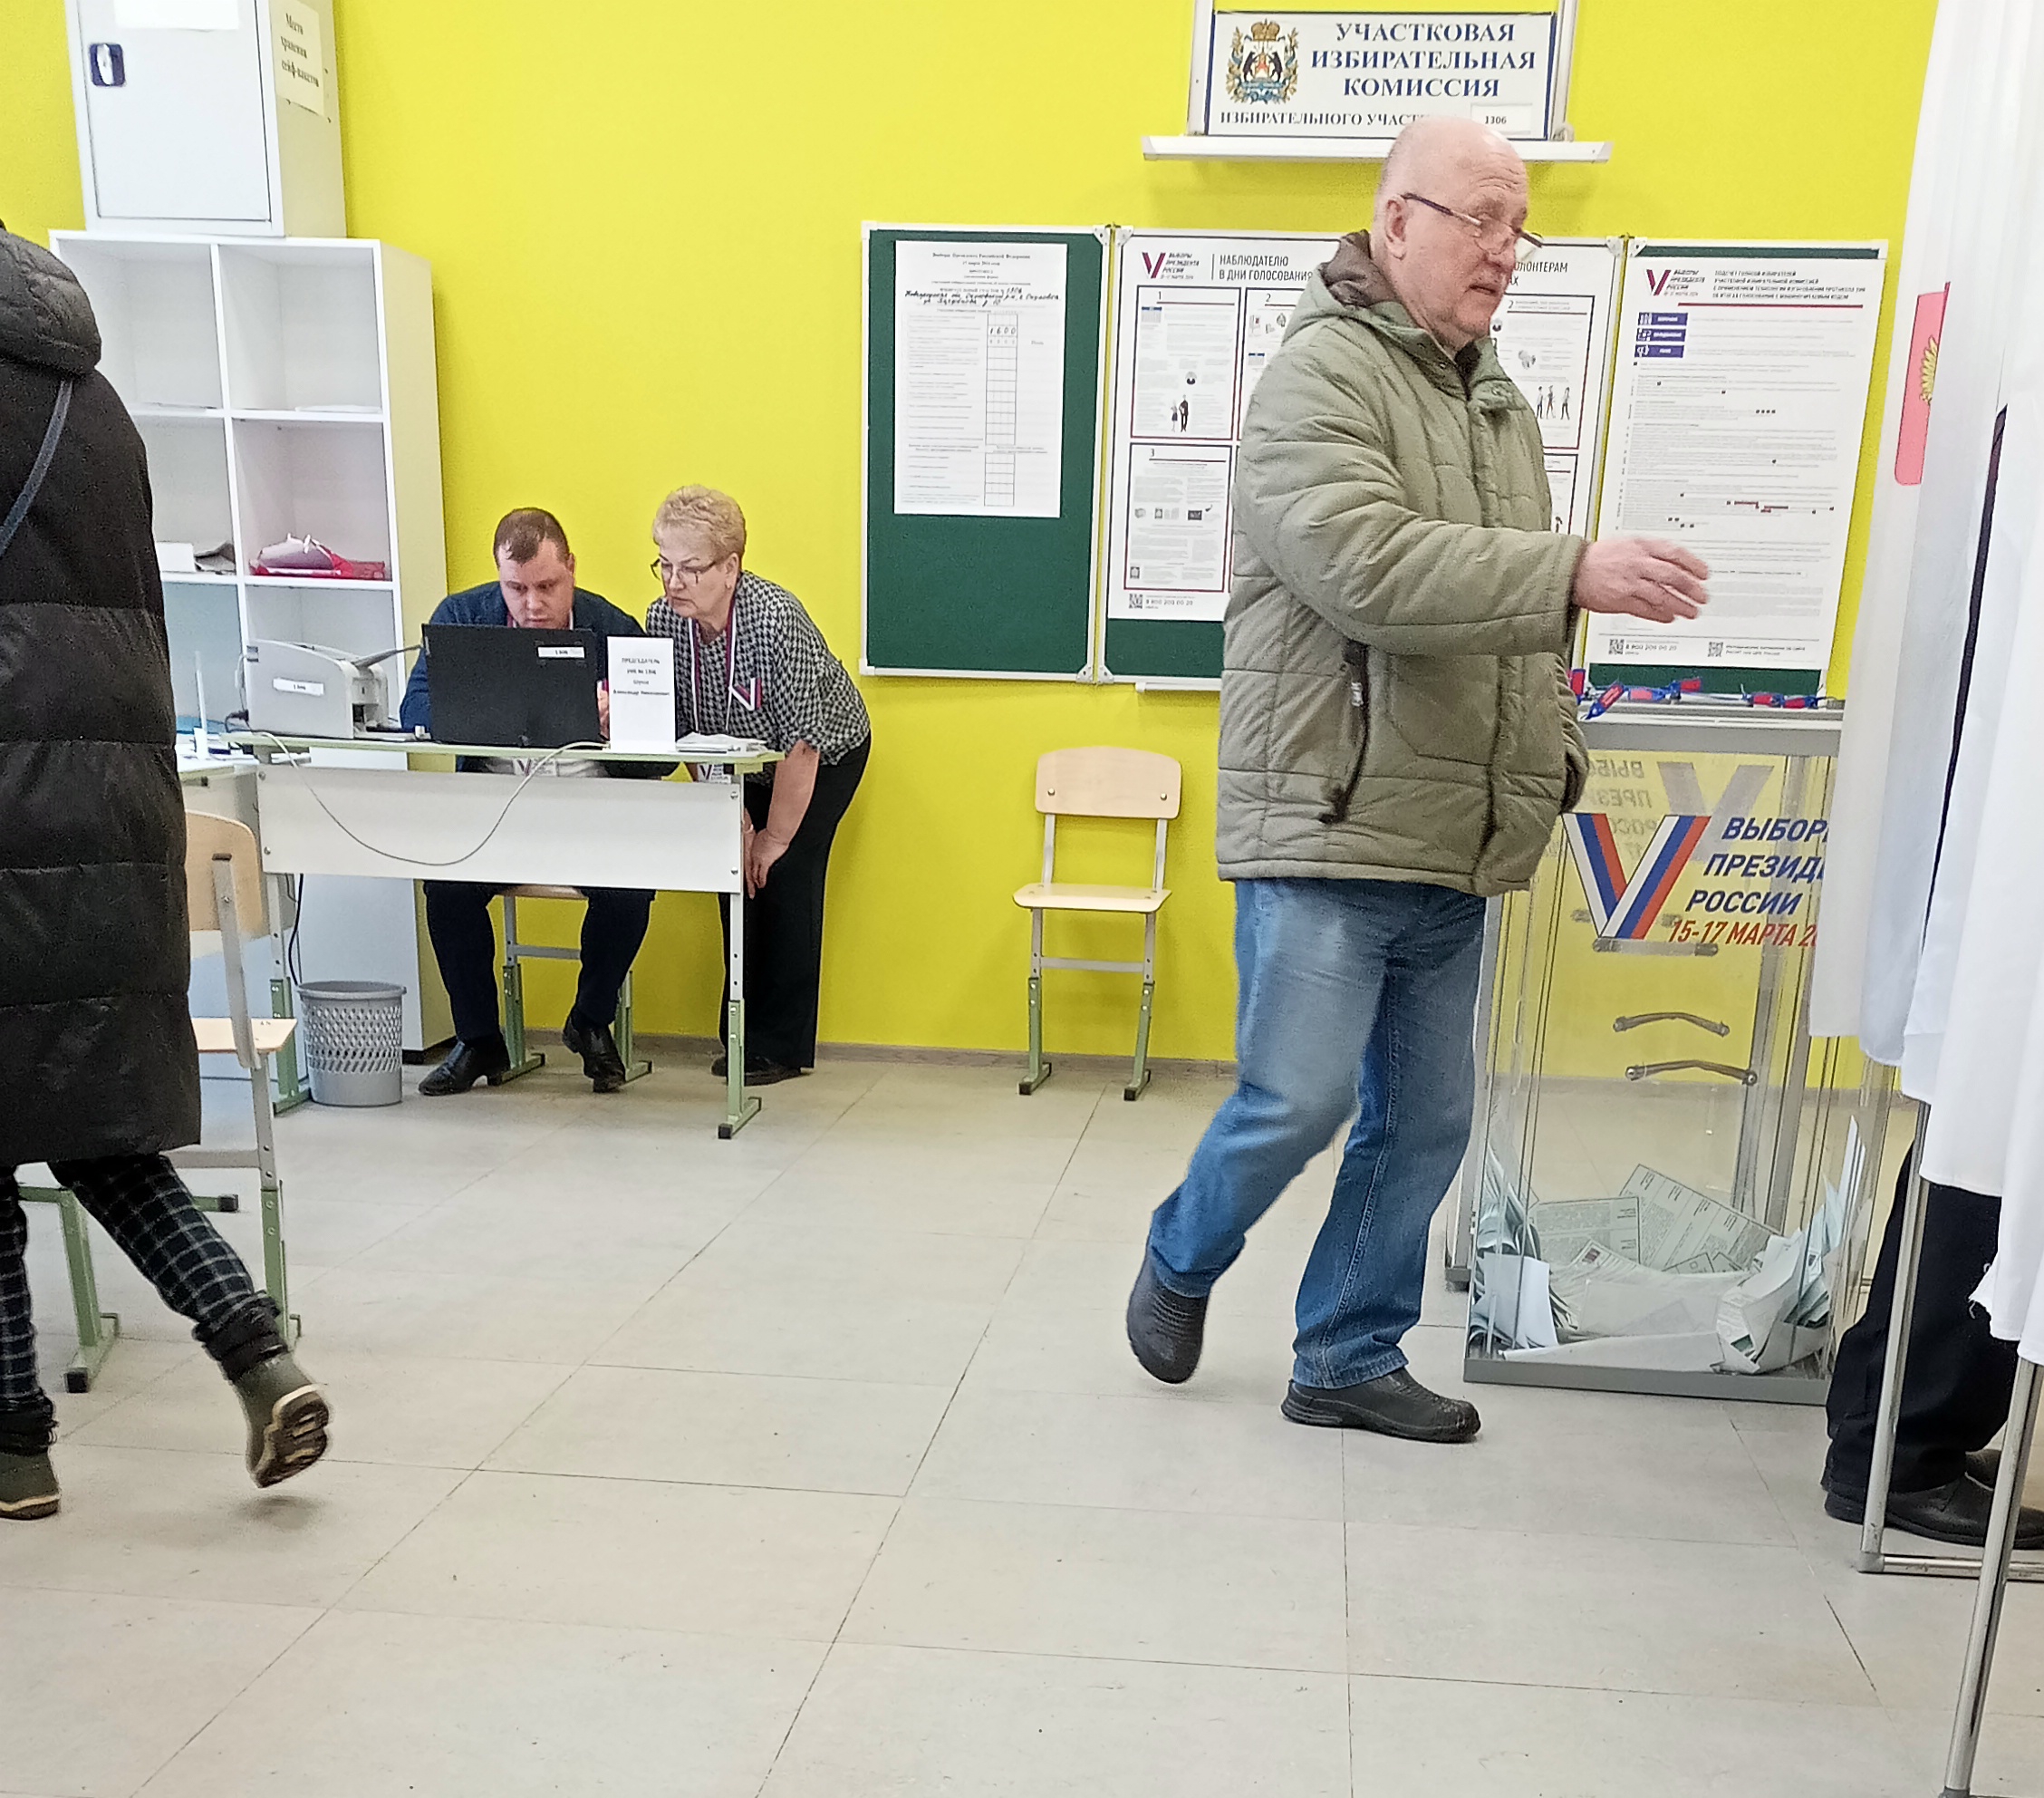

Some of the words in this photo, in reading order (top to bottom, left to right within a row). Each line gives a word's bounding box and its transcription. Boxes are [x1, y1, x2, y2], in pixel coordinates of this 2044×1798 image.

[1335, 22, 1515, 43] УЧАСТКОВАЯ
[1311, 49, 1537, 71] ИЗБИРАТЕЛЬНАЯ
[1343, 77, 1500, 98] КОМИССИЯ
[1220, 111, 1363, 125] ИЗБИРАТЕЛЬНОГО
[1366, 113, 1429, 126] УЧАСТ
[1484, 115, 1508, 125] 1306
[1220, 255, 1289, 267] НАБЛЮДАТЕЛЮ
[1514, 261, 1568, 273] ОЛОНТЕРАМ
[1219, 269, 1225, 280] В
[1227, 269, 1247, 282] ДНИ
[1249, 270, 1314, 282] ГОЛОСОВАНИЯ
[1266, 293, 1272, 303] 2
[1508, 300, 1514, 309] 2
[1721, 817, 1830, 843] ВЫБОР
[1703, 853, 1825, 884] ПРЕЗИД
[1684, 889, 1804, 915] РОССИИ
[1669, 919, 1729, 944] 15-17
[1724, 921, 1798, 947] МАРТА
